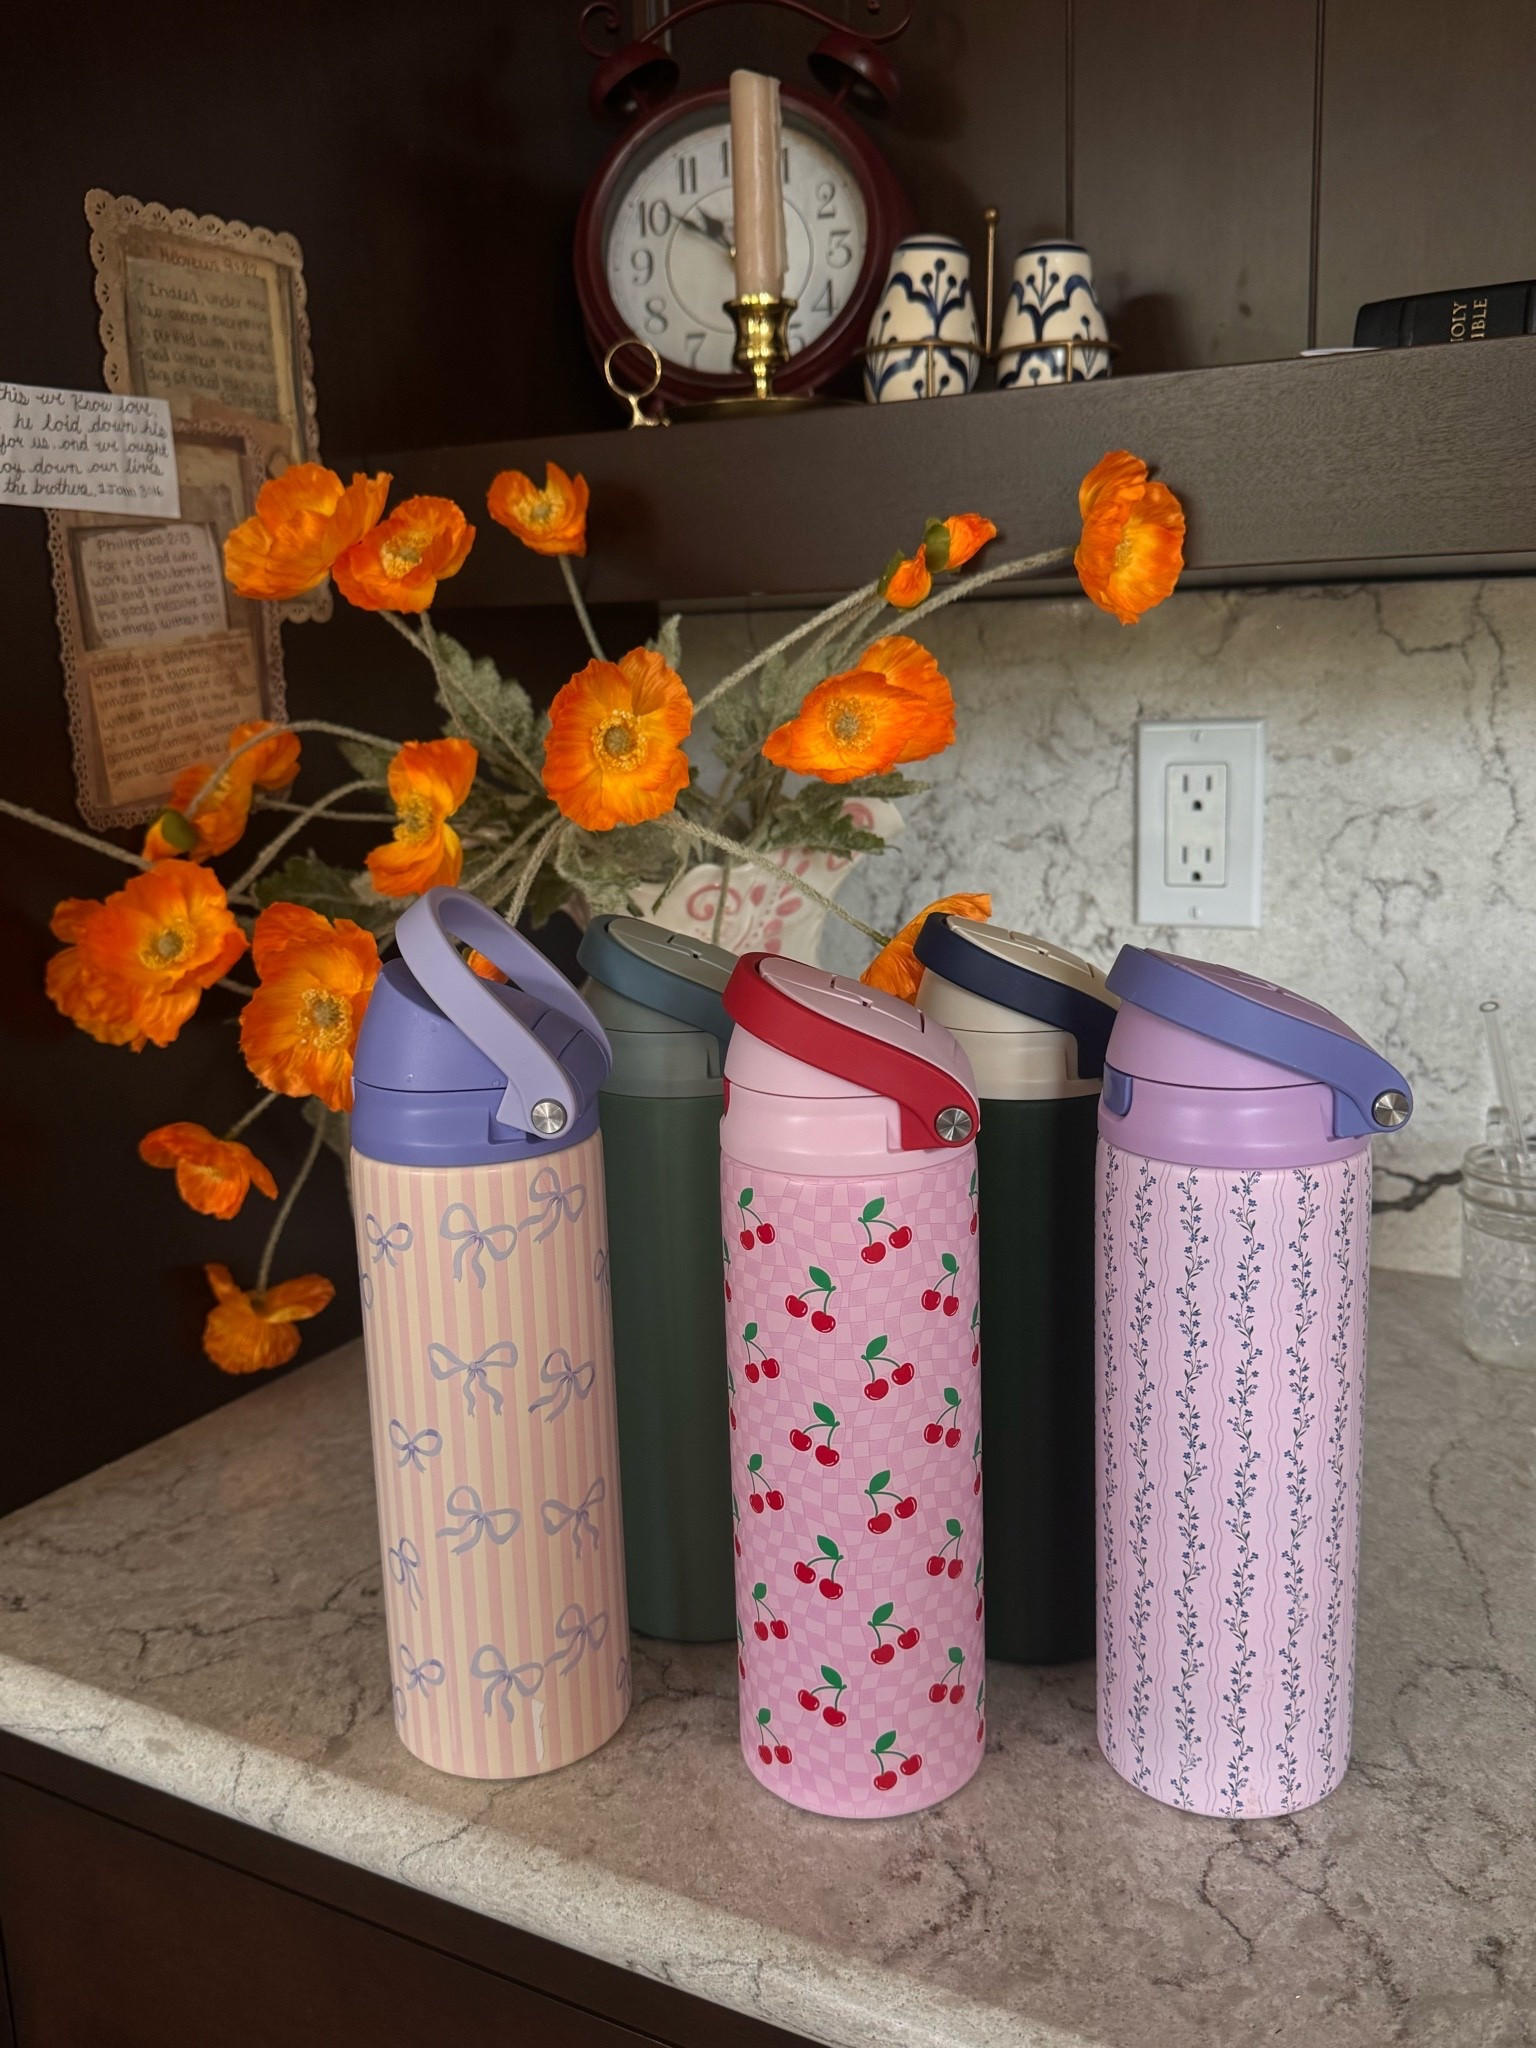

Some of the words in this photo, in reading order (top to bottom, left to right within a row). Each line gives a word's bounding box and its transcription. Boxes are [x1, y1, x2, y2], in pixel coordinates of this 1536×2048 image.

[677, 156, 697, 195] 11
[638, 200, 671, 238] 10
[815, 182, 836, 220] 2
[630, 249, 654, 286] 9
[826, 230, 852, 269] 3
[644, 298, 668, 335] 8
[811, 279, 838, 318] 4
[684, 332, 707, 370] 7
[36, 391, 66, 407] we
[13, 412, 34, 431] he
[87, 413, 138, 435] down
[140, 418, 168, 440] his
[58, 433, 90, 453] and
[95, 440, 120, 453] we
[126, 440, 169, 463] ought
[0, 461, 26, 481] ay
[29, 456, 83, 475] down
[87, 461, 119, 474] our
[124, 458, 164, 477] lives
[3, 477, 28, 496] the
[107, 483, 137, 498] John
[97, 534, 164, 551] Philippians
[121, 586, 145, 602] and
